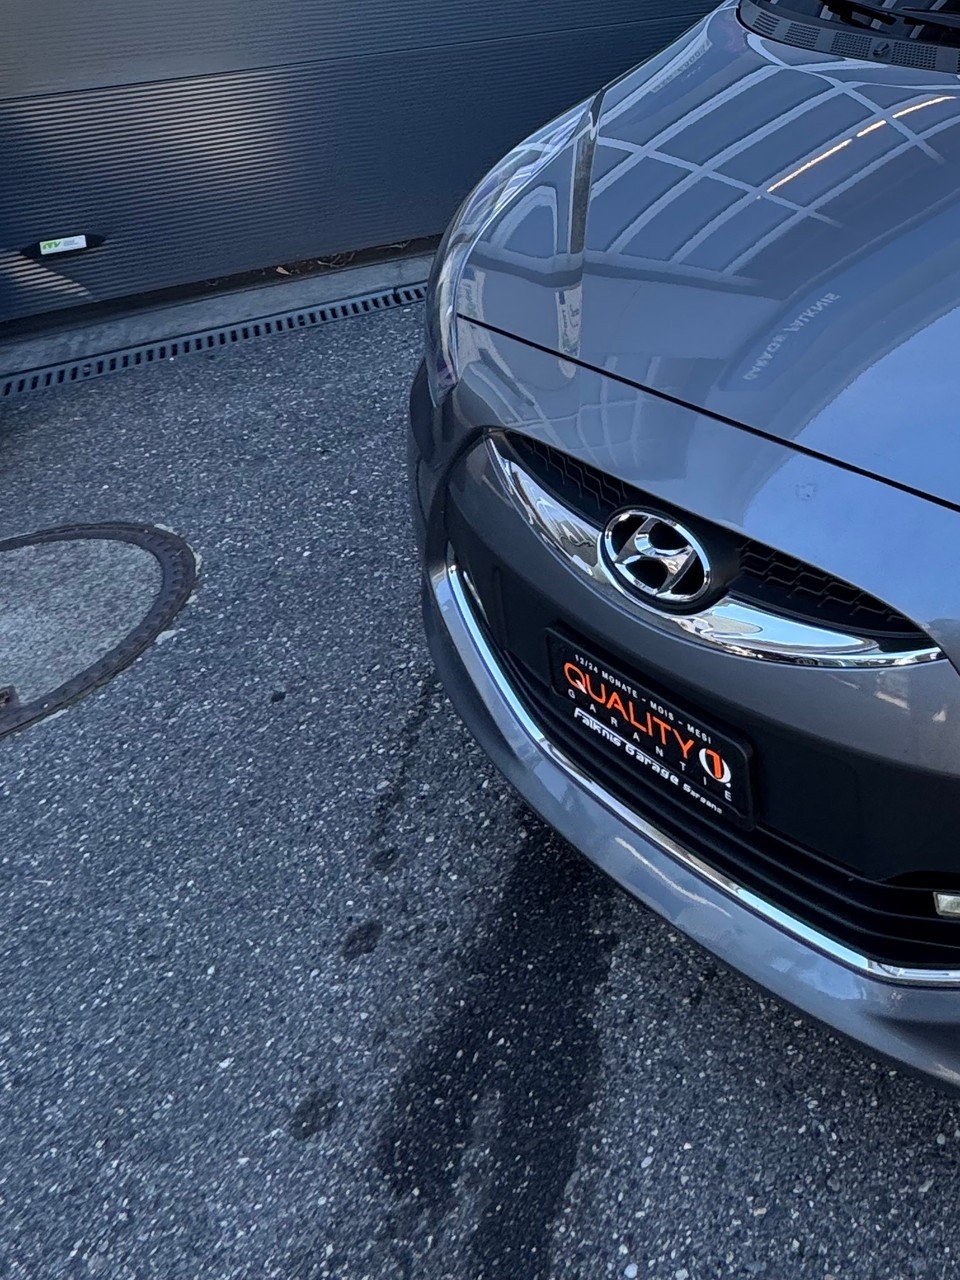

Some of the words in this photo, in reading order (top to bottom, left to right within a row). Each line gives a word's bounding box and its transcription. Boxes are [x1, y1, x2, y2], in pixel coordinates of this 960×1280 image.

[563, 662, 695, 760] QUALITY
[575, 654, 599, 674] 12/24
[601, 670, 639, 699] MONATE
[649, 700, 675, 721] MOIS
[687, 723, 712, 745] MESI
[574, 707, 622, 748] Falknis
[625, 741, 680, 787] Garage
